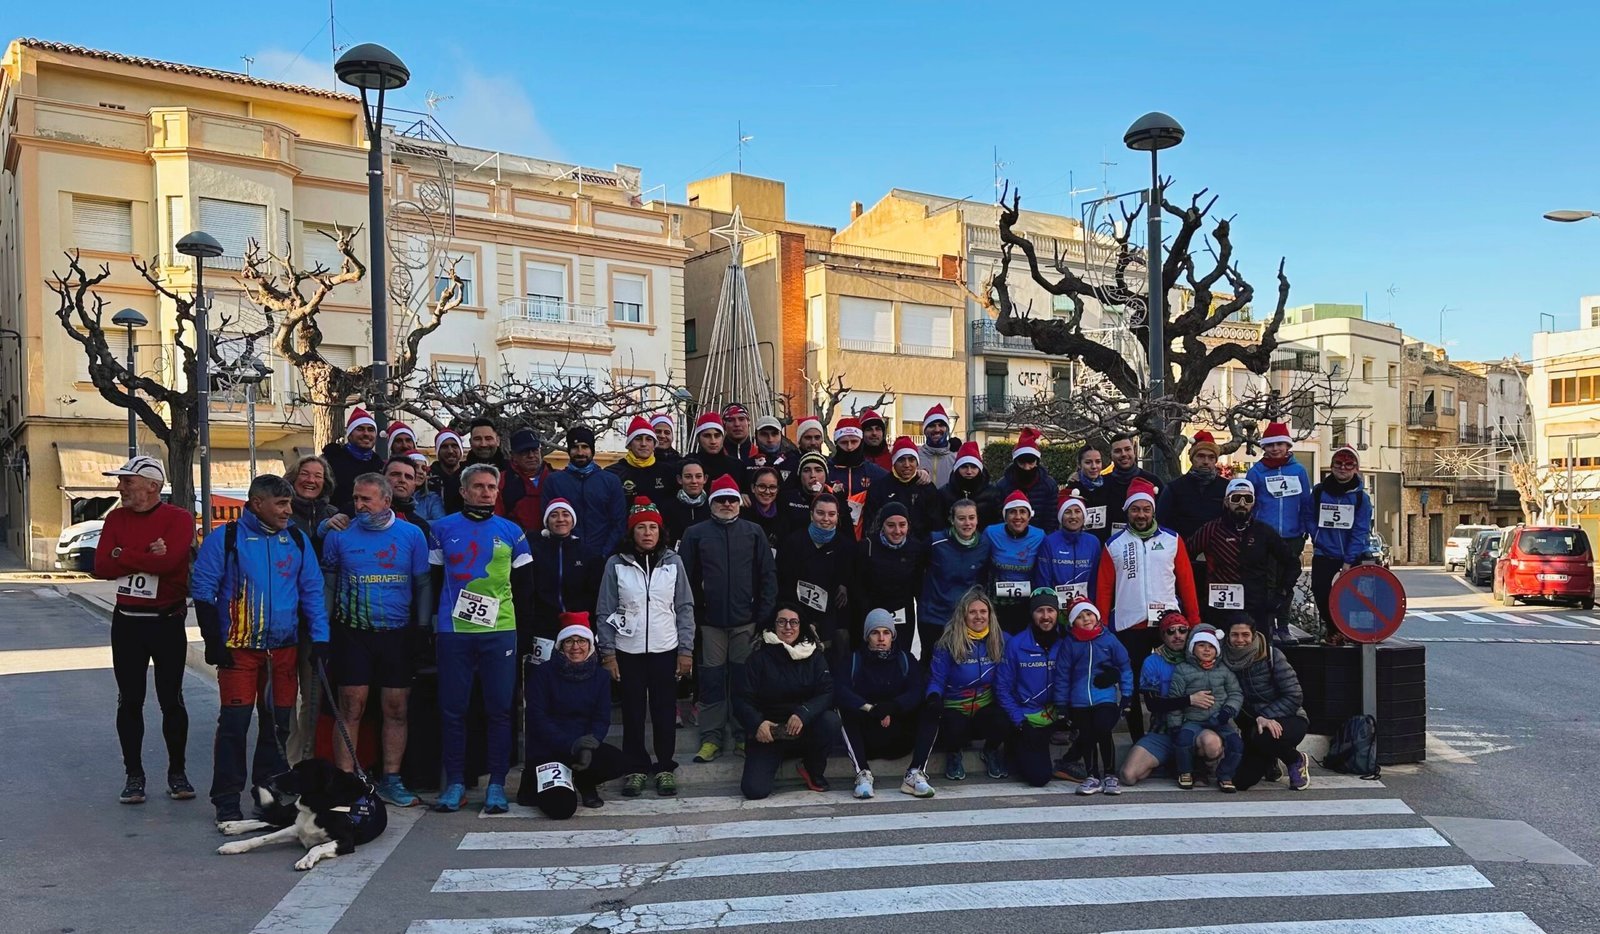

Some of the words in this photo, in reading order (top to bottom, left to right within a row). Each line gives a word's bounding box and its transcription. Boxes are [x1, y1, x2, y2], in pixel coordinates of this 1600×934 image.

[1280, 480, 1288, 490] 4
[1090, 513, 1101, 524] 15
[1332, 511, 1341, 522] 5
[127, 575, 146, 589] 10
[806, 589, 820, 602] 12
[1006, 588, 1022, 598] 16
[1218, 591, 1234, 602] 31
[466, 601, 488, 617] 35
[619, 615, 626, 628] 3
[552, 769, 562, 780] 2
